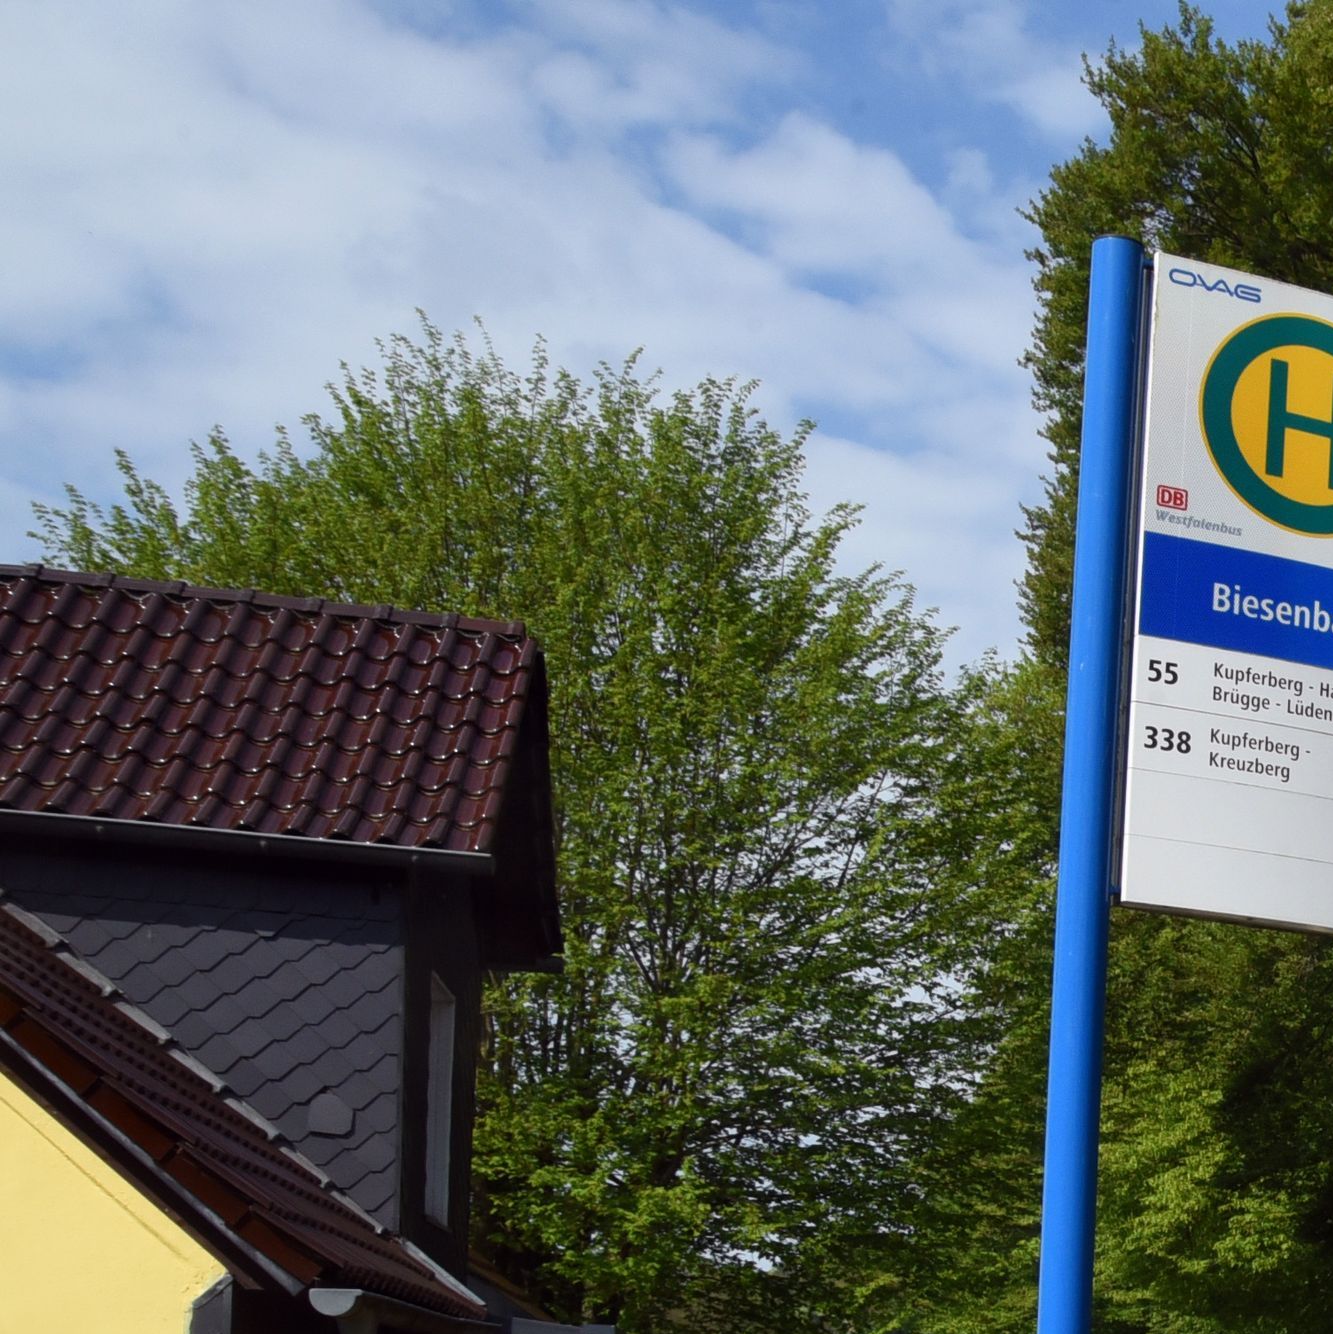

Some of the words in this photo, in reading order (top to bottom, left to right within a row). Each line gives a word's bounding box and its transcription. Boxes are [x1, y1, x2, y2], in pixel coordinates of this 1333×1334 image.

[1168, 267, 1262, 303] OVAG
[1160, 488, 1184, 506] DB
[1156, 509, 1242, 536] Westfalenbus
[1147, 659, 1179, 685] 55
[1213, 662, 1304, 697] Kupferberg
[1212, 685, 1271, 713] Brügge
[1143, 725, 1192, 754] 338
[1209, 727, 1301, 762] Kupferberg
[1208, 751, 1291, 783] Kreuzberg
